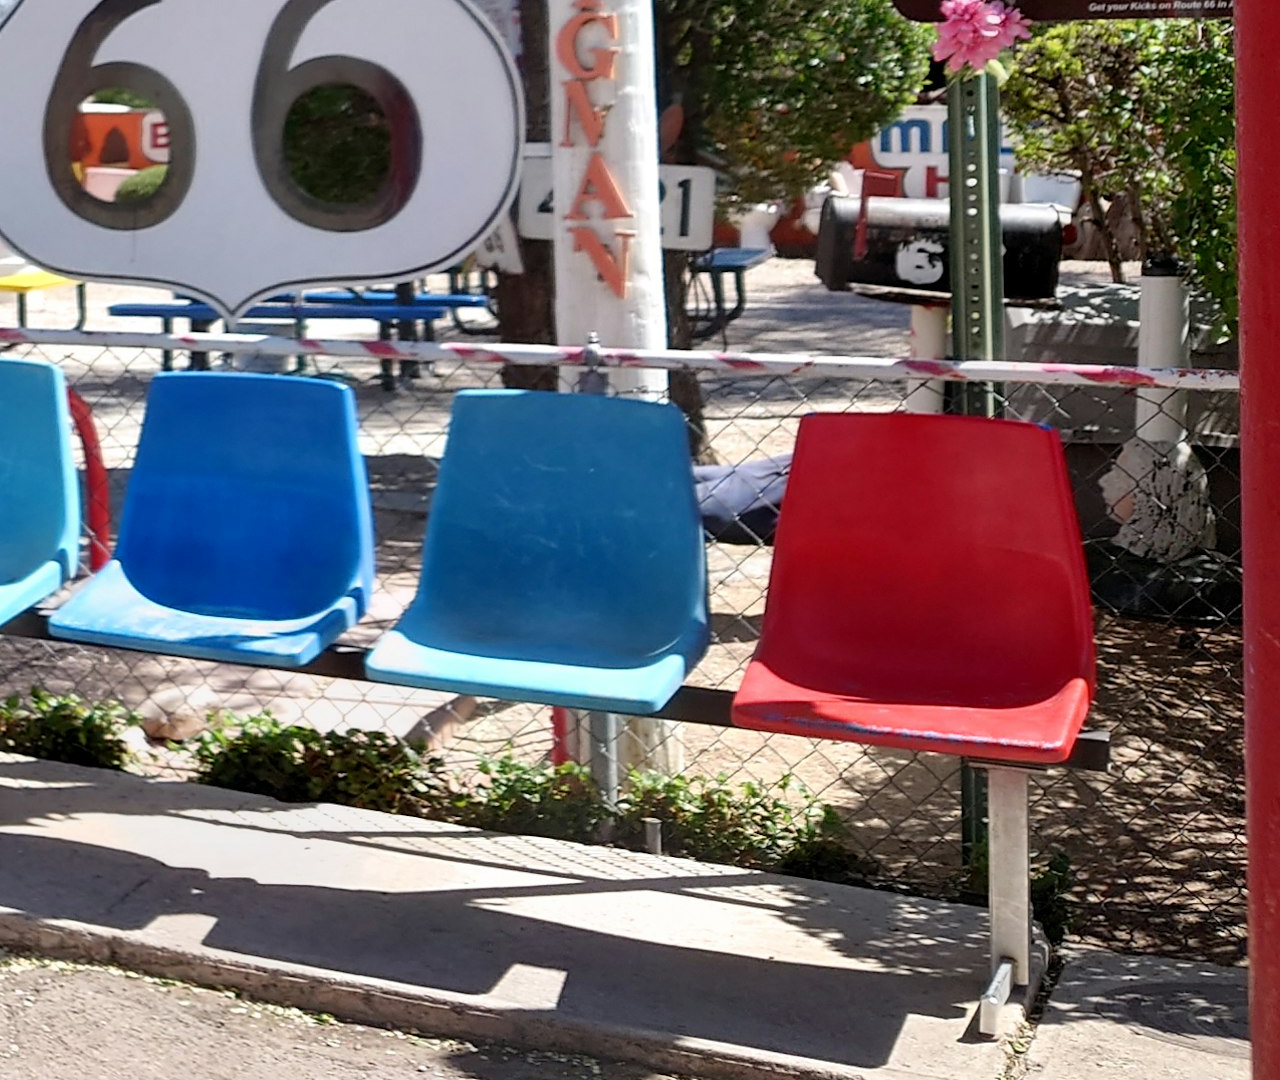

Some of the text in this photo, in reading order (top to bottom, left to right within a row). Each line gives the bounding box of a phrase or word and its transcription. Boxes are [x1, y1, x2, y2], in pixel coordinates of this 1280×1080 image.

[1107, 3, 1129, 14] your
[1130, 0, 1157, 11] Kicks
[1158, 2, 1172, 10] on
[1173, 0, 1202, 10] Route
[1203, 0, 1215, 9] 66
